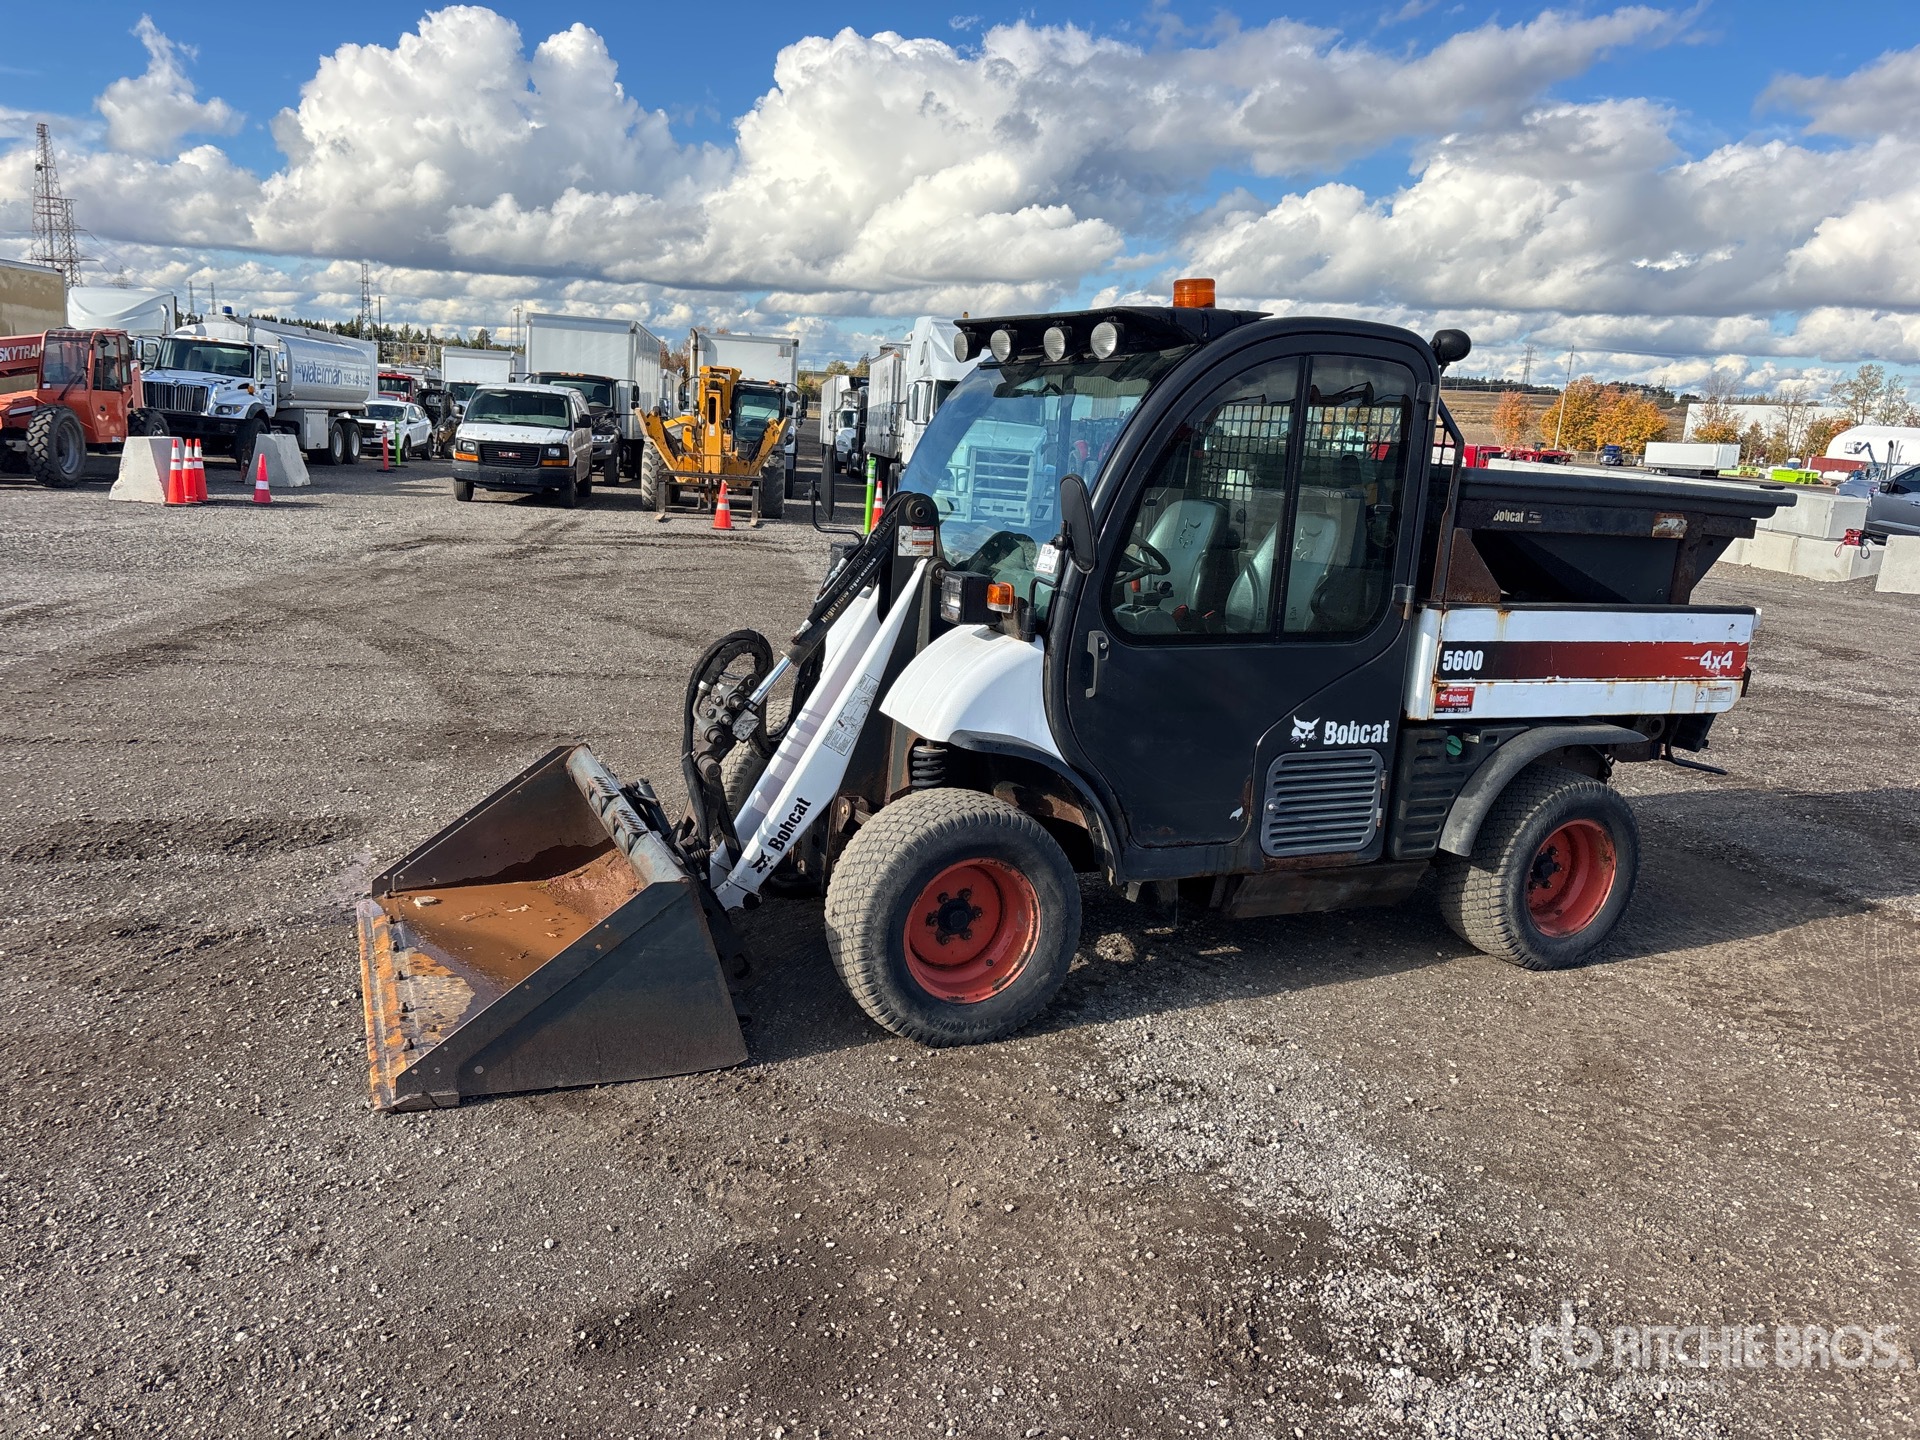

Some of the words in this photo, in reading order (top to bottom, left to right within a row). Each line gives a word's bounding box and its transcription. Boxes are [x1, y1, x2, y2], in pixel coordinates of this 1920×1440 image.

[301, 361, 342, 385] waterman
[1442, 650, 1484, 671] 5600
[1699, 650, 1734, 670] 4x4
[1448, 694, 1469, 703] Bobcat
[1323, 720, 1390, 745] Bobcat
[767, 796, 812, 853] Bobcat
